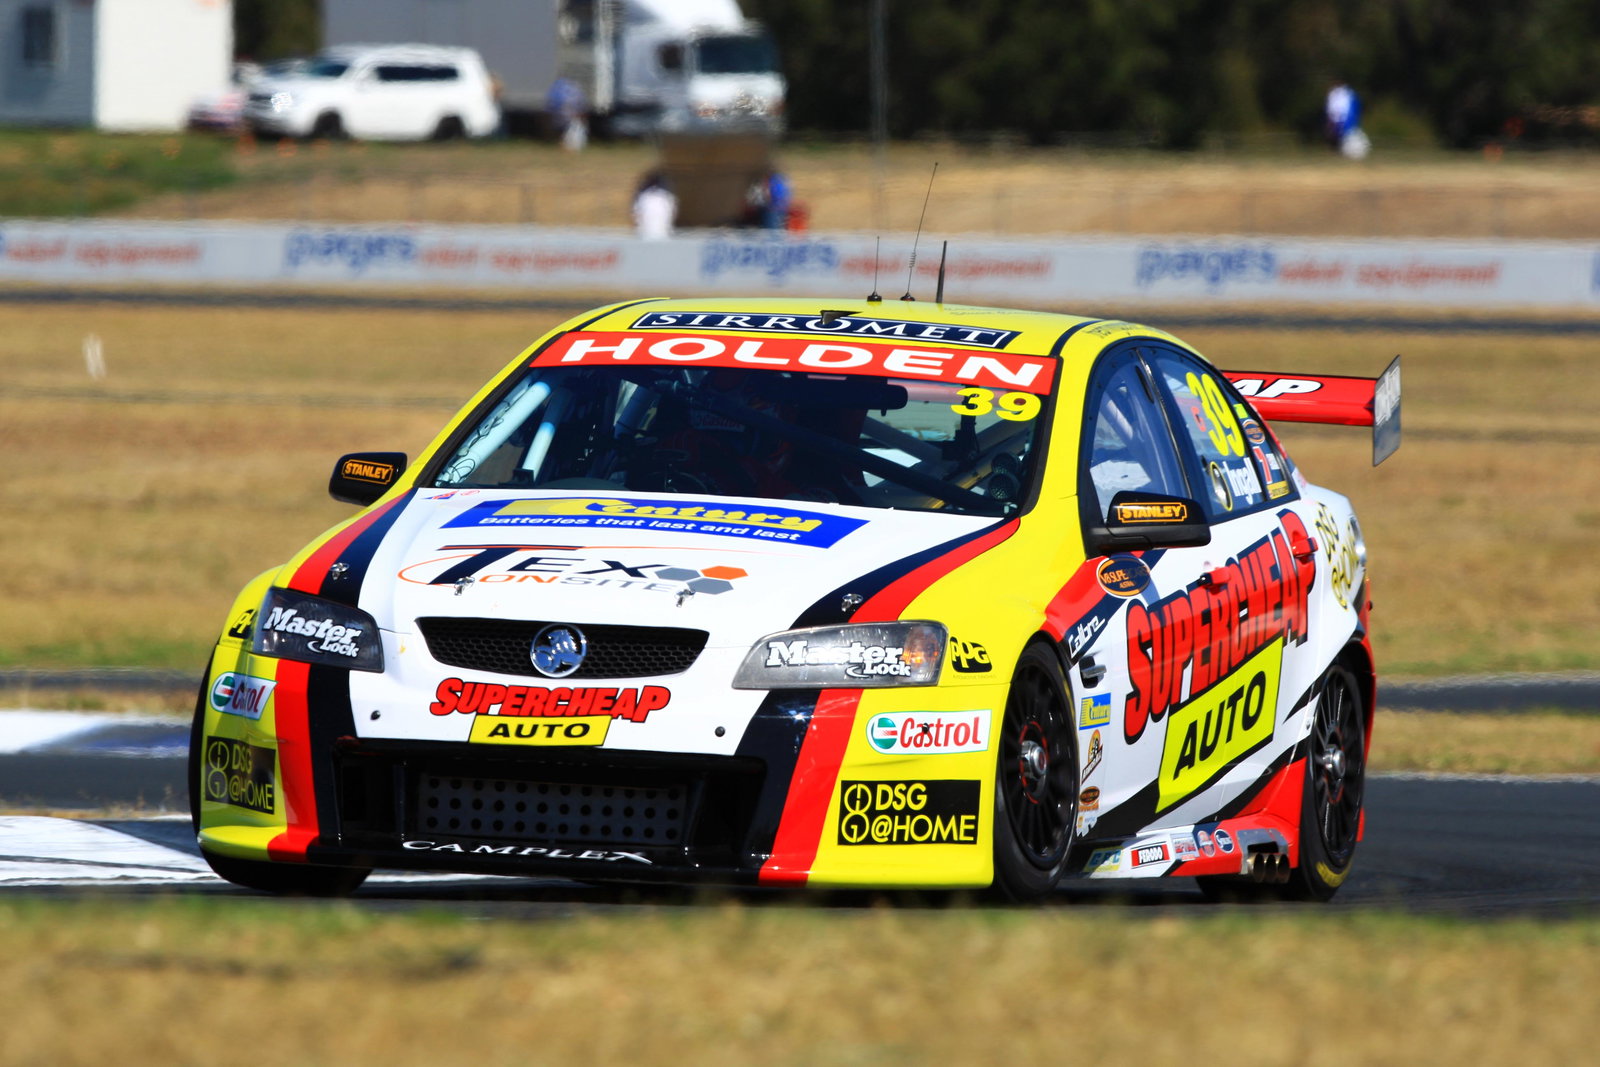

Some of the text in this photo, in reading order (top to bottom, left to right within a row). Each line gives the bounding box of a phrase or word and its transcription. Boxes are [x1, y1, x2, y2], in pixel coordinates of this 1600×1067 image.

[650, 313, 998, 343] SIRROMET
[560, 336, 1044, 387] HOLDEN
[951, 387, 1041, 421] 39
[1185, 372, 1246, 457] 39
[344, 462, 389, 480] STANLEY
[548, 498, 822, 530] Century
[1121, 505, 1182, 519] STANLEY
[478, 516, 801, 541] Batteries that last and last
[478, 573, 680, 593] ONSITE
[263, 606, 363, 644] Master
[1124, 508, 1316, 745] SUPERCHEAP
[319, 637, 359, 658] Lock
[764, 640, 904, 667] Master
[862, 660, 911, 677] Lock
[429, 677, 671, 723] SUPERCHEAP
[487, 722, 591, 739] AUTO
[899, 716, 982, 748] Castrol
[1172, 670, 1267, 781] AUTO
[231, 743, 254, 775] DSG
[228, 774, 273, 810] @HOME
[875, 783, 928, 811] DSG
[871, 814, 976, 843] @HOME
[402, 840, 653, 864] CAMPLEX
